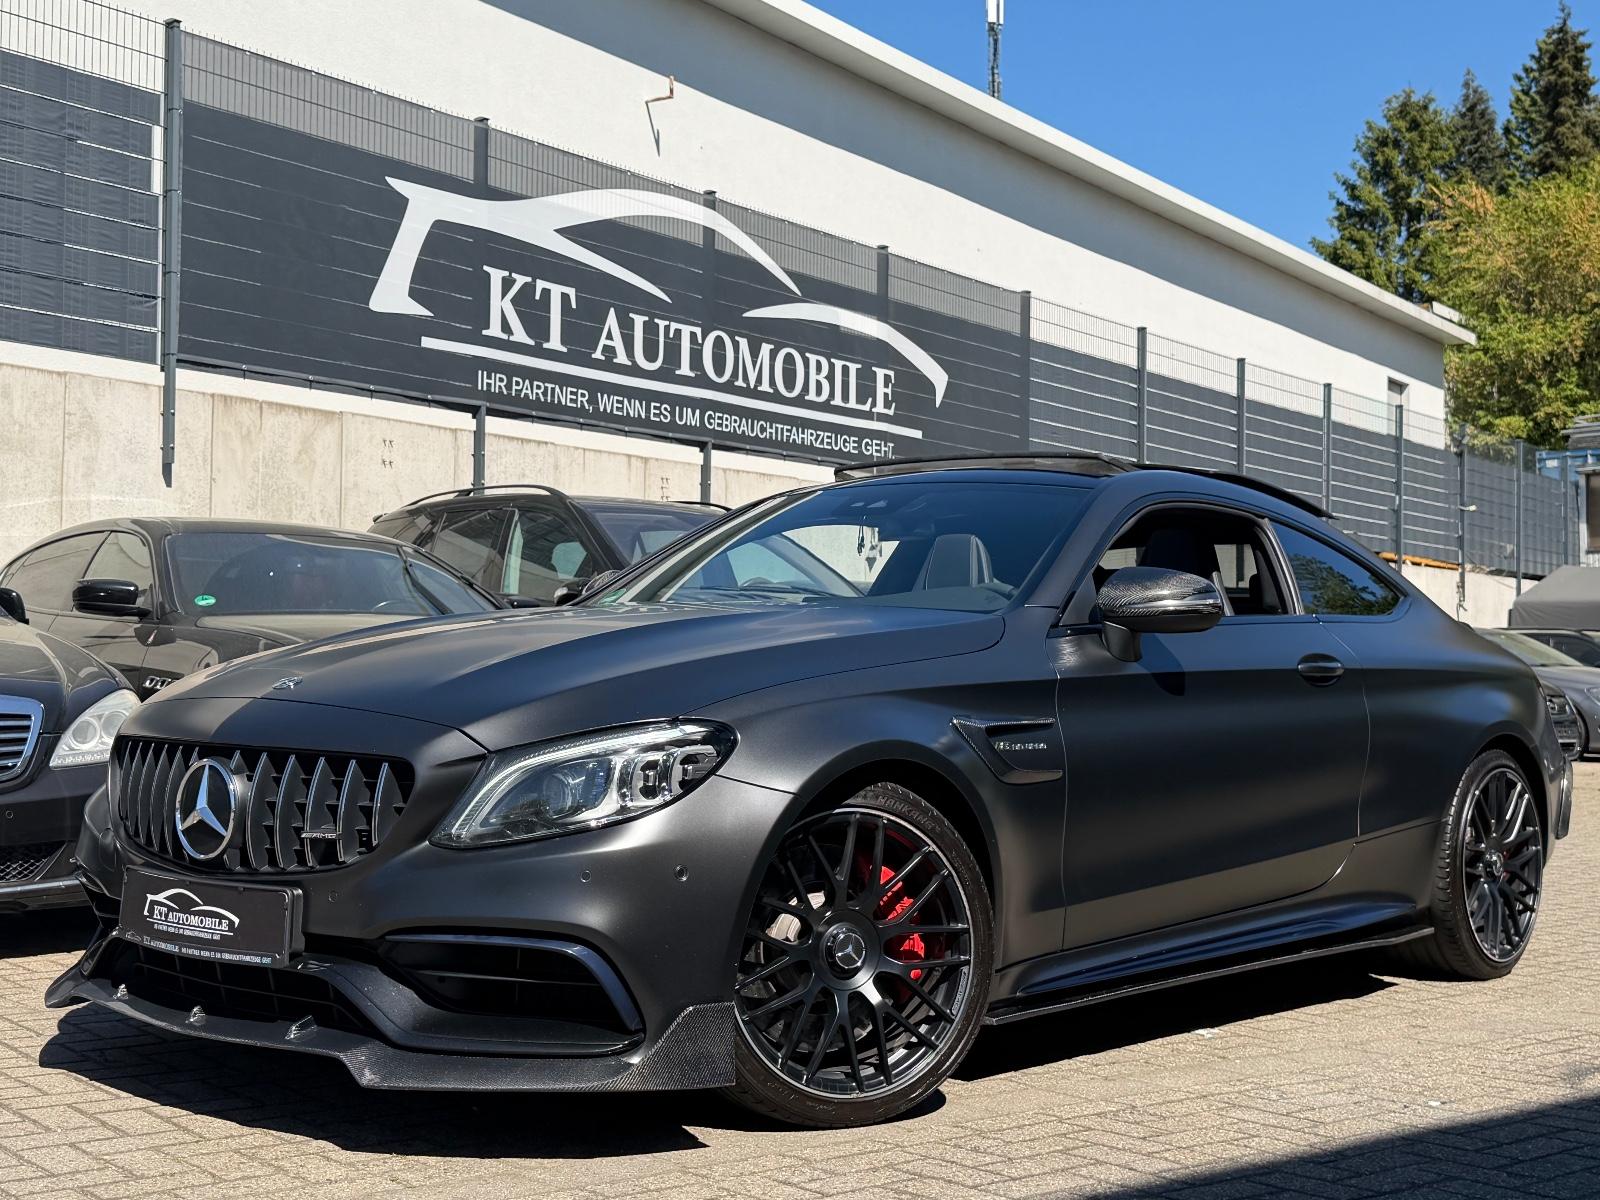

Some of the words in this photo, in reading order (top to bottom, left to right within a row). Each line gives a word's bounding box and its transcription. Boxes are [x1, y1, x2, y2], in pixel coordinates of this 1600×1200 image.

[482, 265, 577, 352] KT
[591, 307, 896, 416] AUTOMOBILE
[477, 370, 508, 395] IHR
[512, 376, 593, 413] PARTNER,
[598, 392, 646, 420] WENN
[650, 402, 671, 423] ES
[675, 406, 700, 427] UM
[704, 410, 859, 454] GEBRAUCHTFAHRZEUGE
[862, 438, 896, 460] GEHT.
[153, 905, 168, 920] KT
[167, 912, 229, 931] AUTOMOBILE
